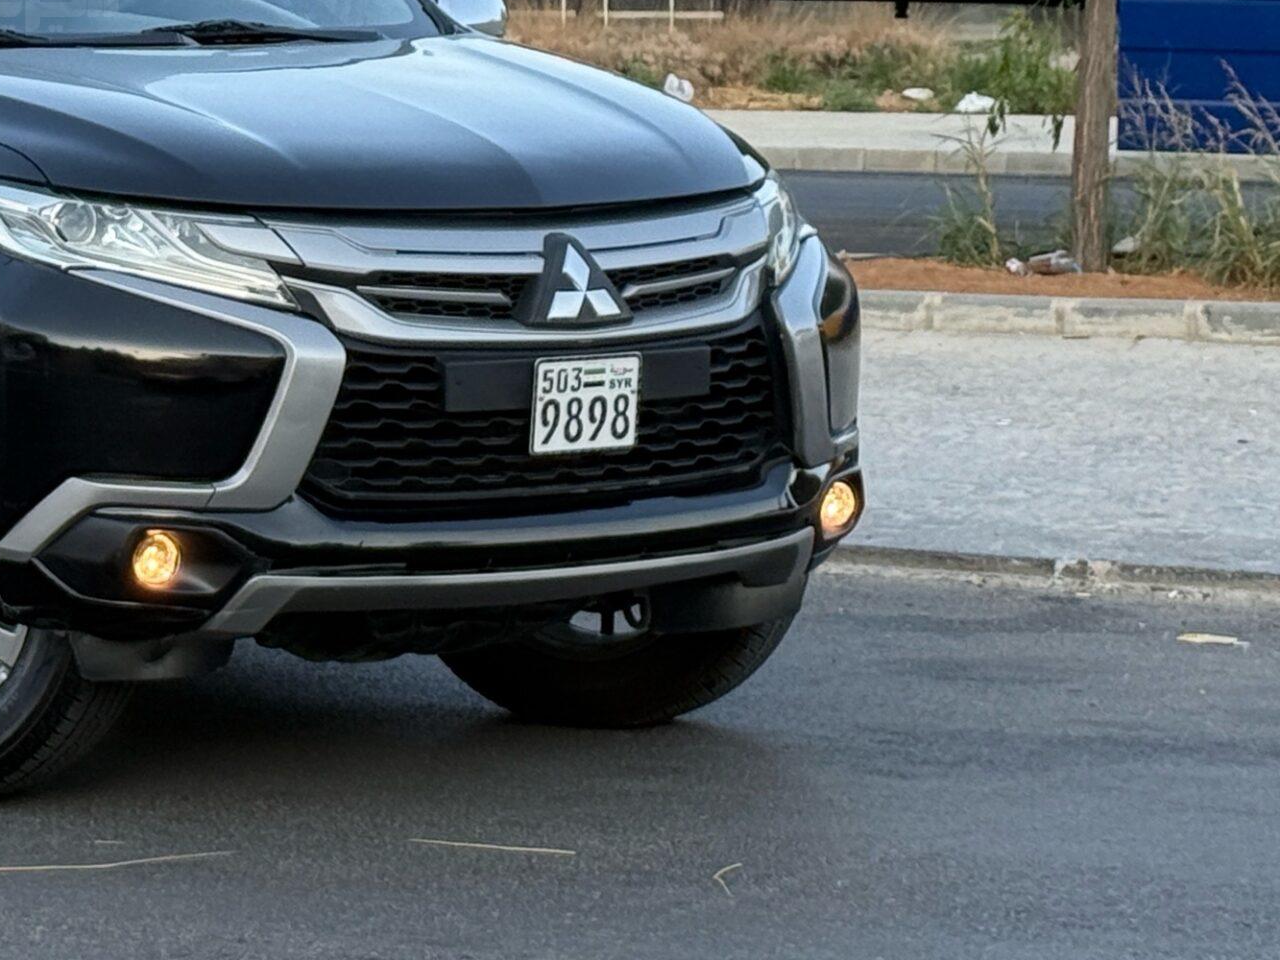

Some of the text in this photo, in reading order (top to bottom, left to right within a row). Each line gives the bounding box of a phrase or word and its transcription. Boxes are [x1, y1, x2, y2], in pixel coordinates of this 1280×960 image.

[542, 367, 583, 393] 503
[608, 377, 632, 389] SYR
[541, 394, 630, 445] 9898
